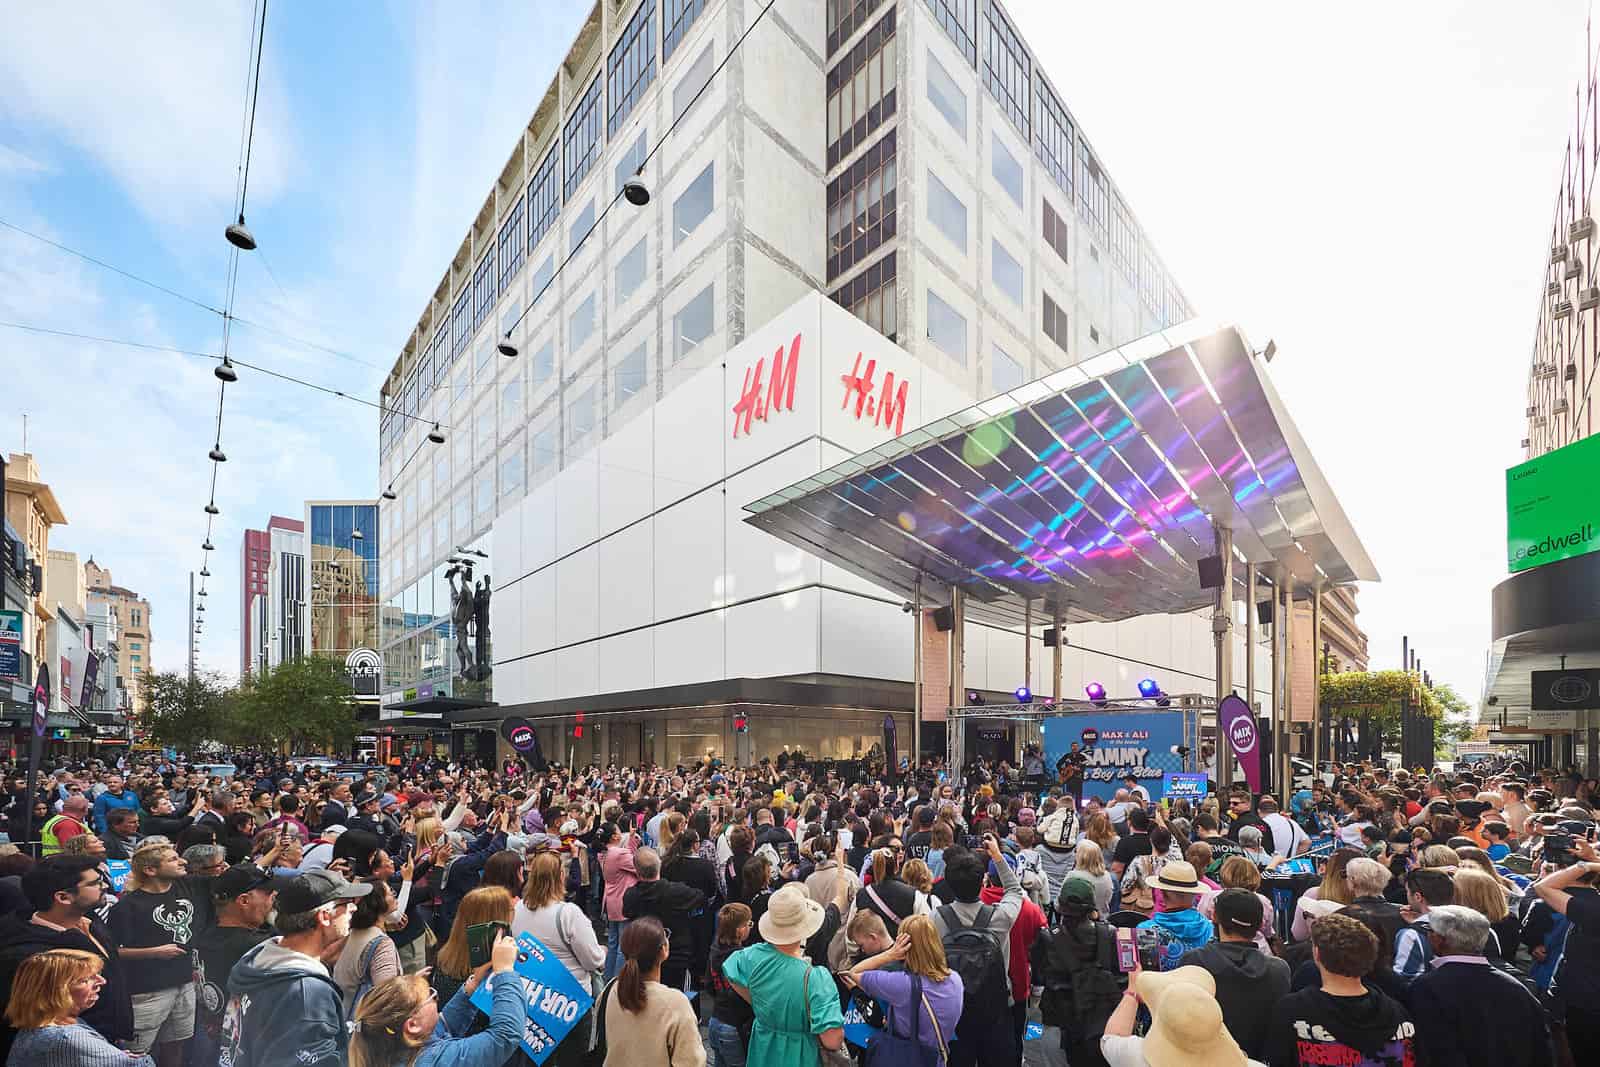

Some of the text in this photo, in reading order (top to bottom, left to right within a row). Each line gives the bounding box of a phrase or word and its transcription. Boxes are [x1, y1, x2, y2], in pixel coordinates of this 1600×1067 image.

[732, 332, 802, 438] H&M
[841, 352, 908, 436] H&M
[1102, 731, 1123, 739] MAX
[1132, 731, 1148, 739] ALI
[1234, 726, 1252, 740] MIX
[1080, 747, 1148, 767] SAMMY
[1090, 767, 1114, 783] Boy
[1132, 766, 1163, 778] Blue
[540, 988, 578, 1022] OUR
